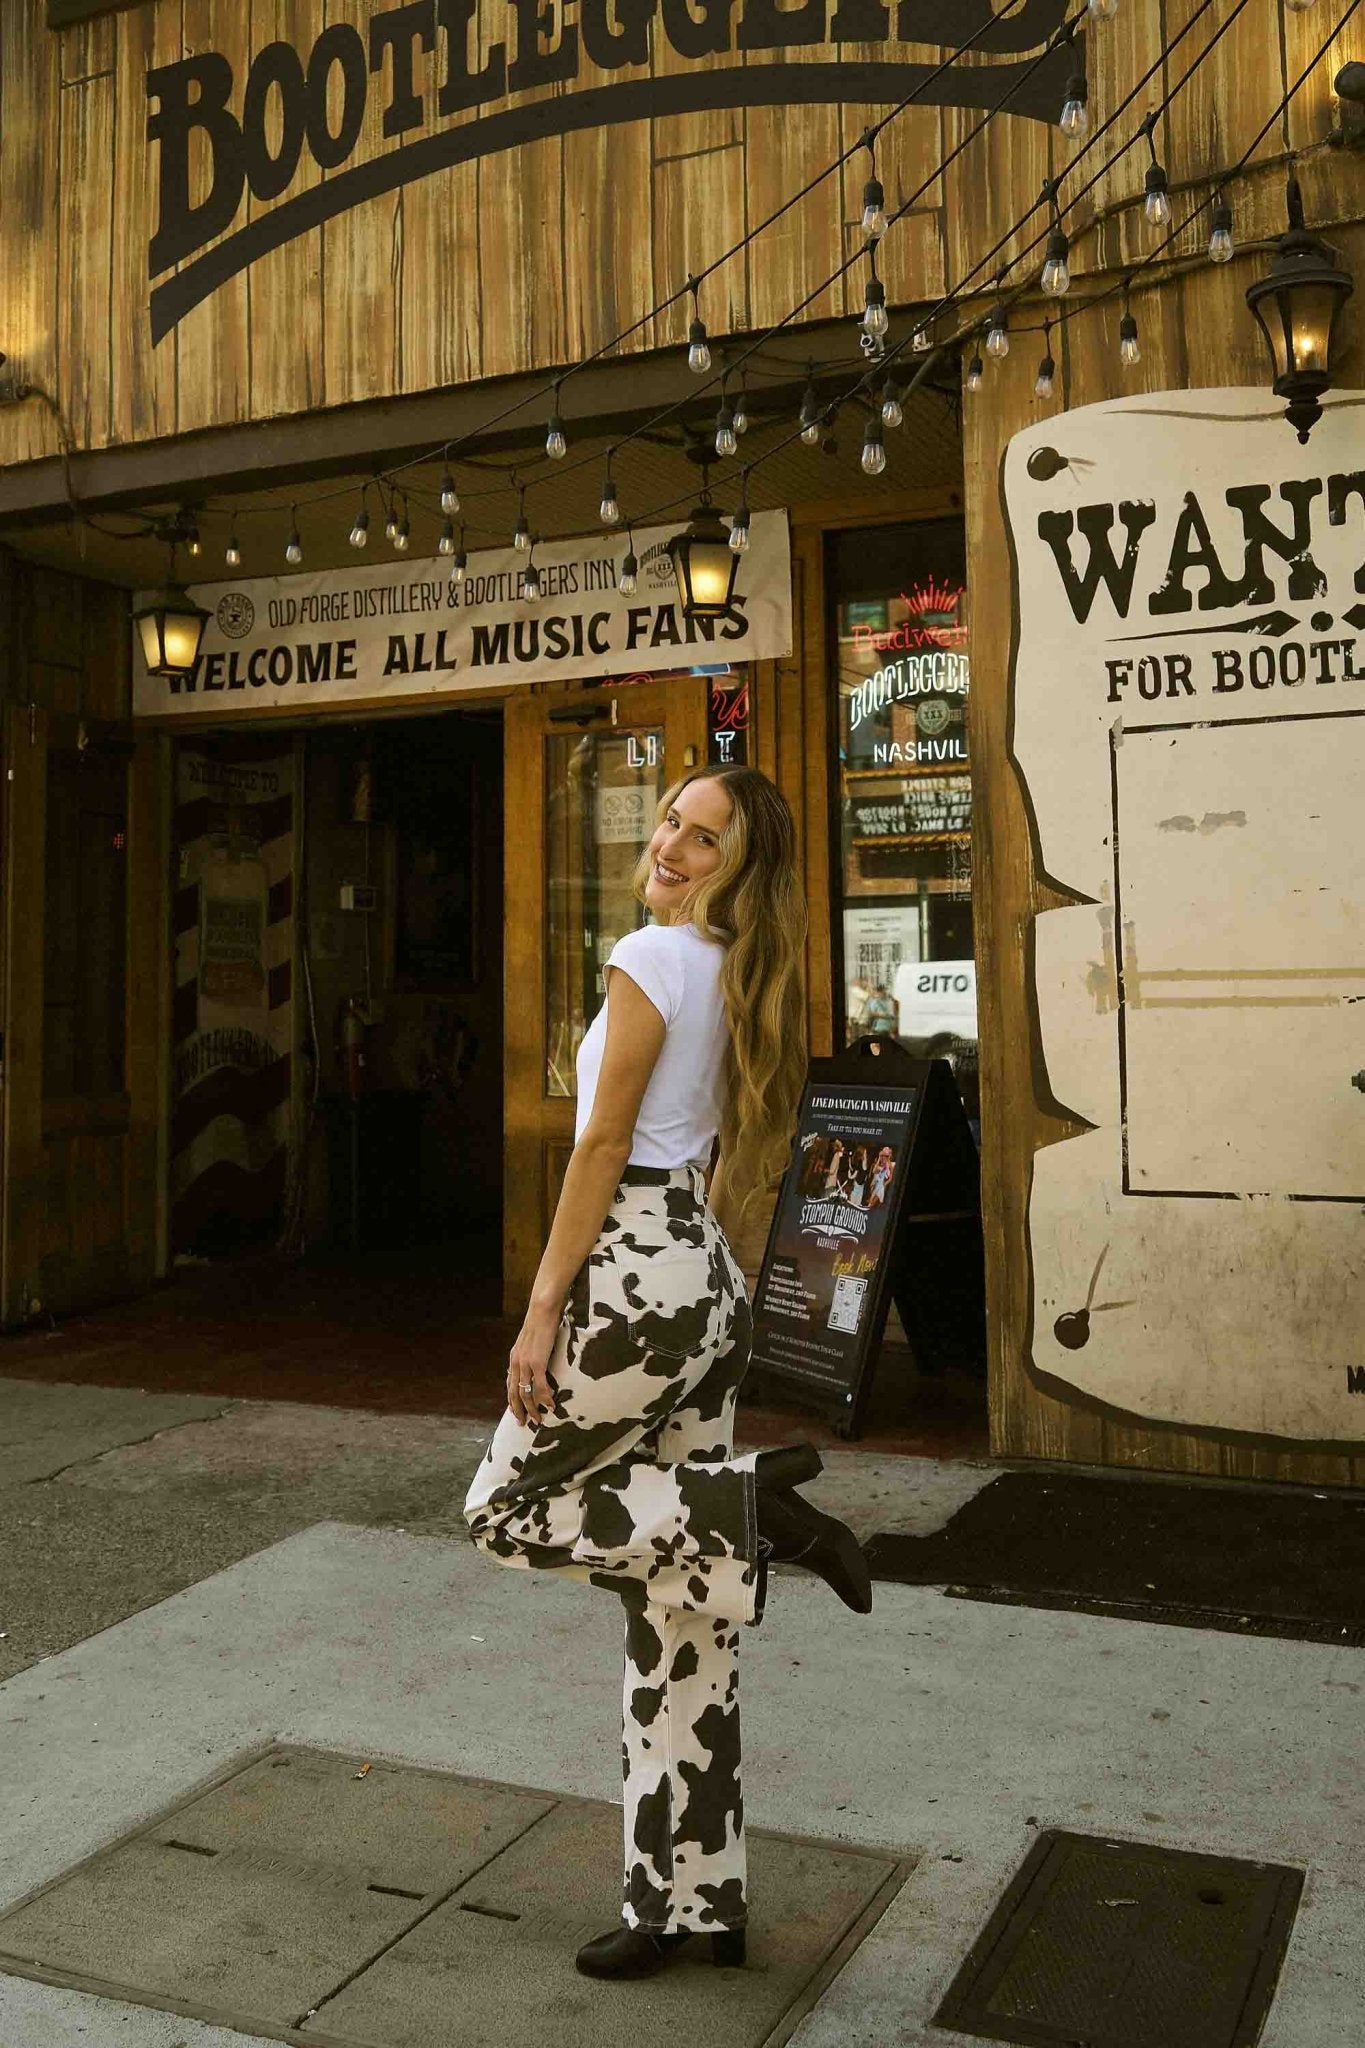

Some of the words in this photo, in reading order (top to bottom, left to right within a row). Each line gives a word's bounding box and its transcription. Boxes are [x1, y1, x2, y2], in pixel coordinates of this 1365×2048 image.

[268, 599, 296, 629] OLD
[299, 591, 350, 625] FORGE
[354, 581, 443, 619] DISTILLERY
[447, 582, 460, 609] &
[464, 563, 579, 607] BOOTLEGERS
[584, 558, 618, 592] INN
[383, 630, 457, 676] ALL
[470, 612, 611, 667] MUSIC
[625, 595, 749, 651] FANS
[851, 620, 968, 653] Budwei
[1105, 655, 1197, 702] FOR
